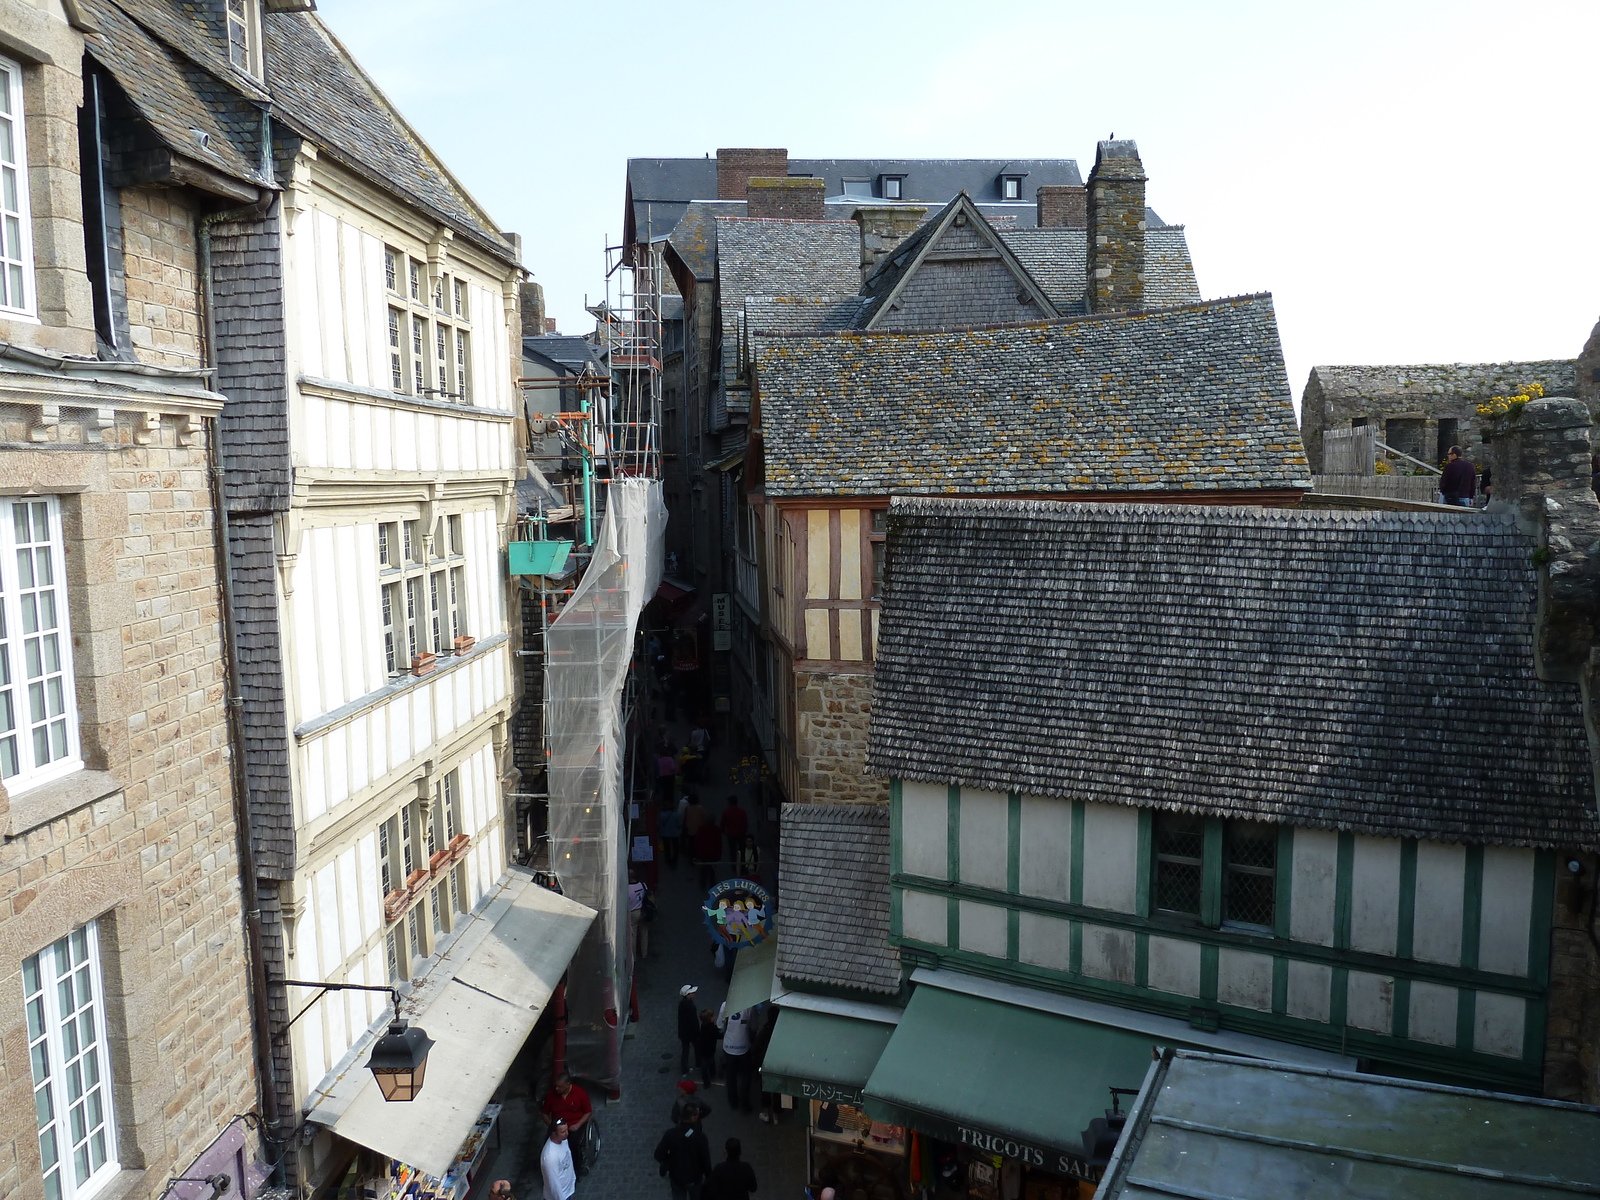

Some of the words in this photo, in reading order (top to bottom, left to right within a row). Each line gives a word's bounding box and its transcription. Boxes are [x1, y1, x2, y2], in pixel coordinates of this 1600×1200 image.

[711, 882, 731, 898] LES
[957, 1126, 1044, 1166] TRICOTS
[1058, 1156, 1097, 1182] SAI
